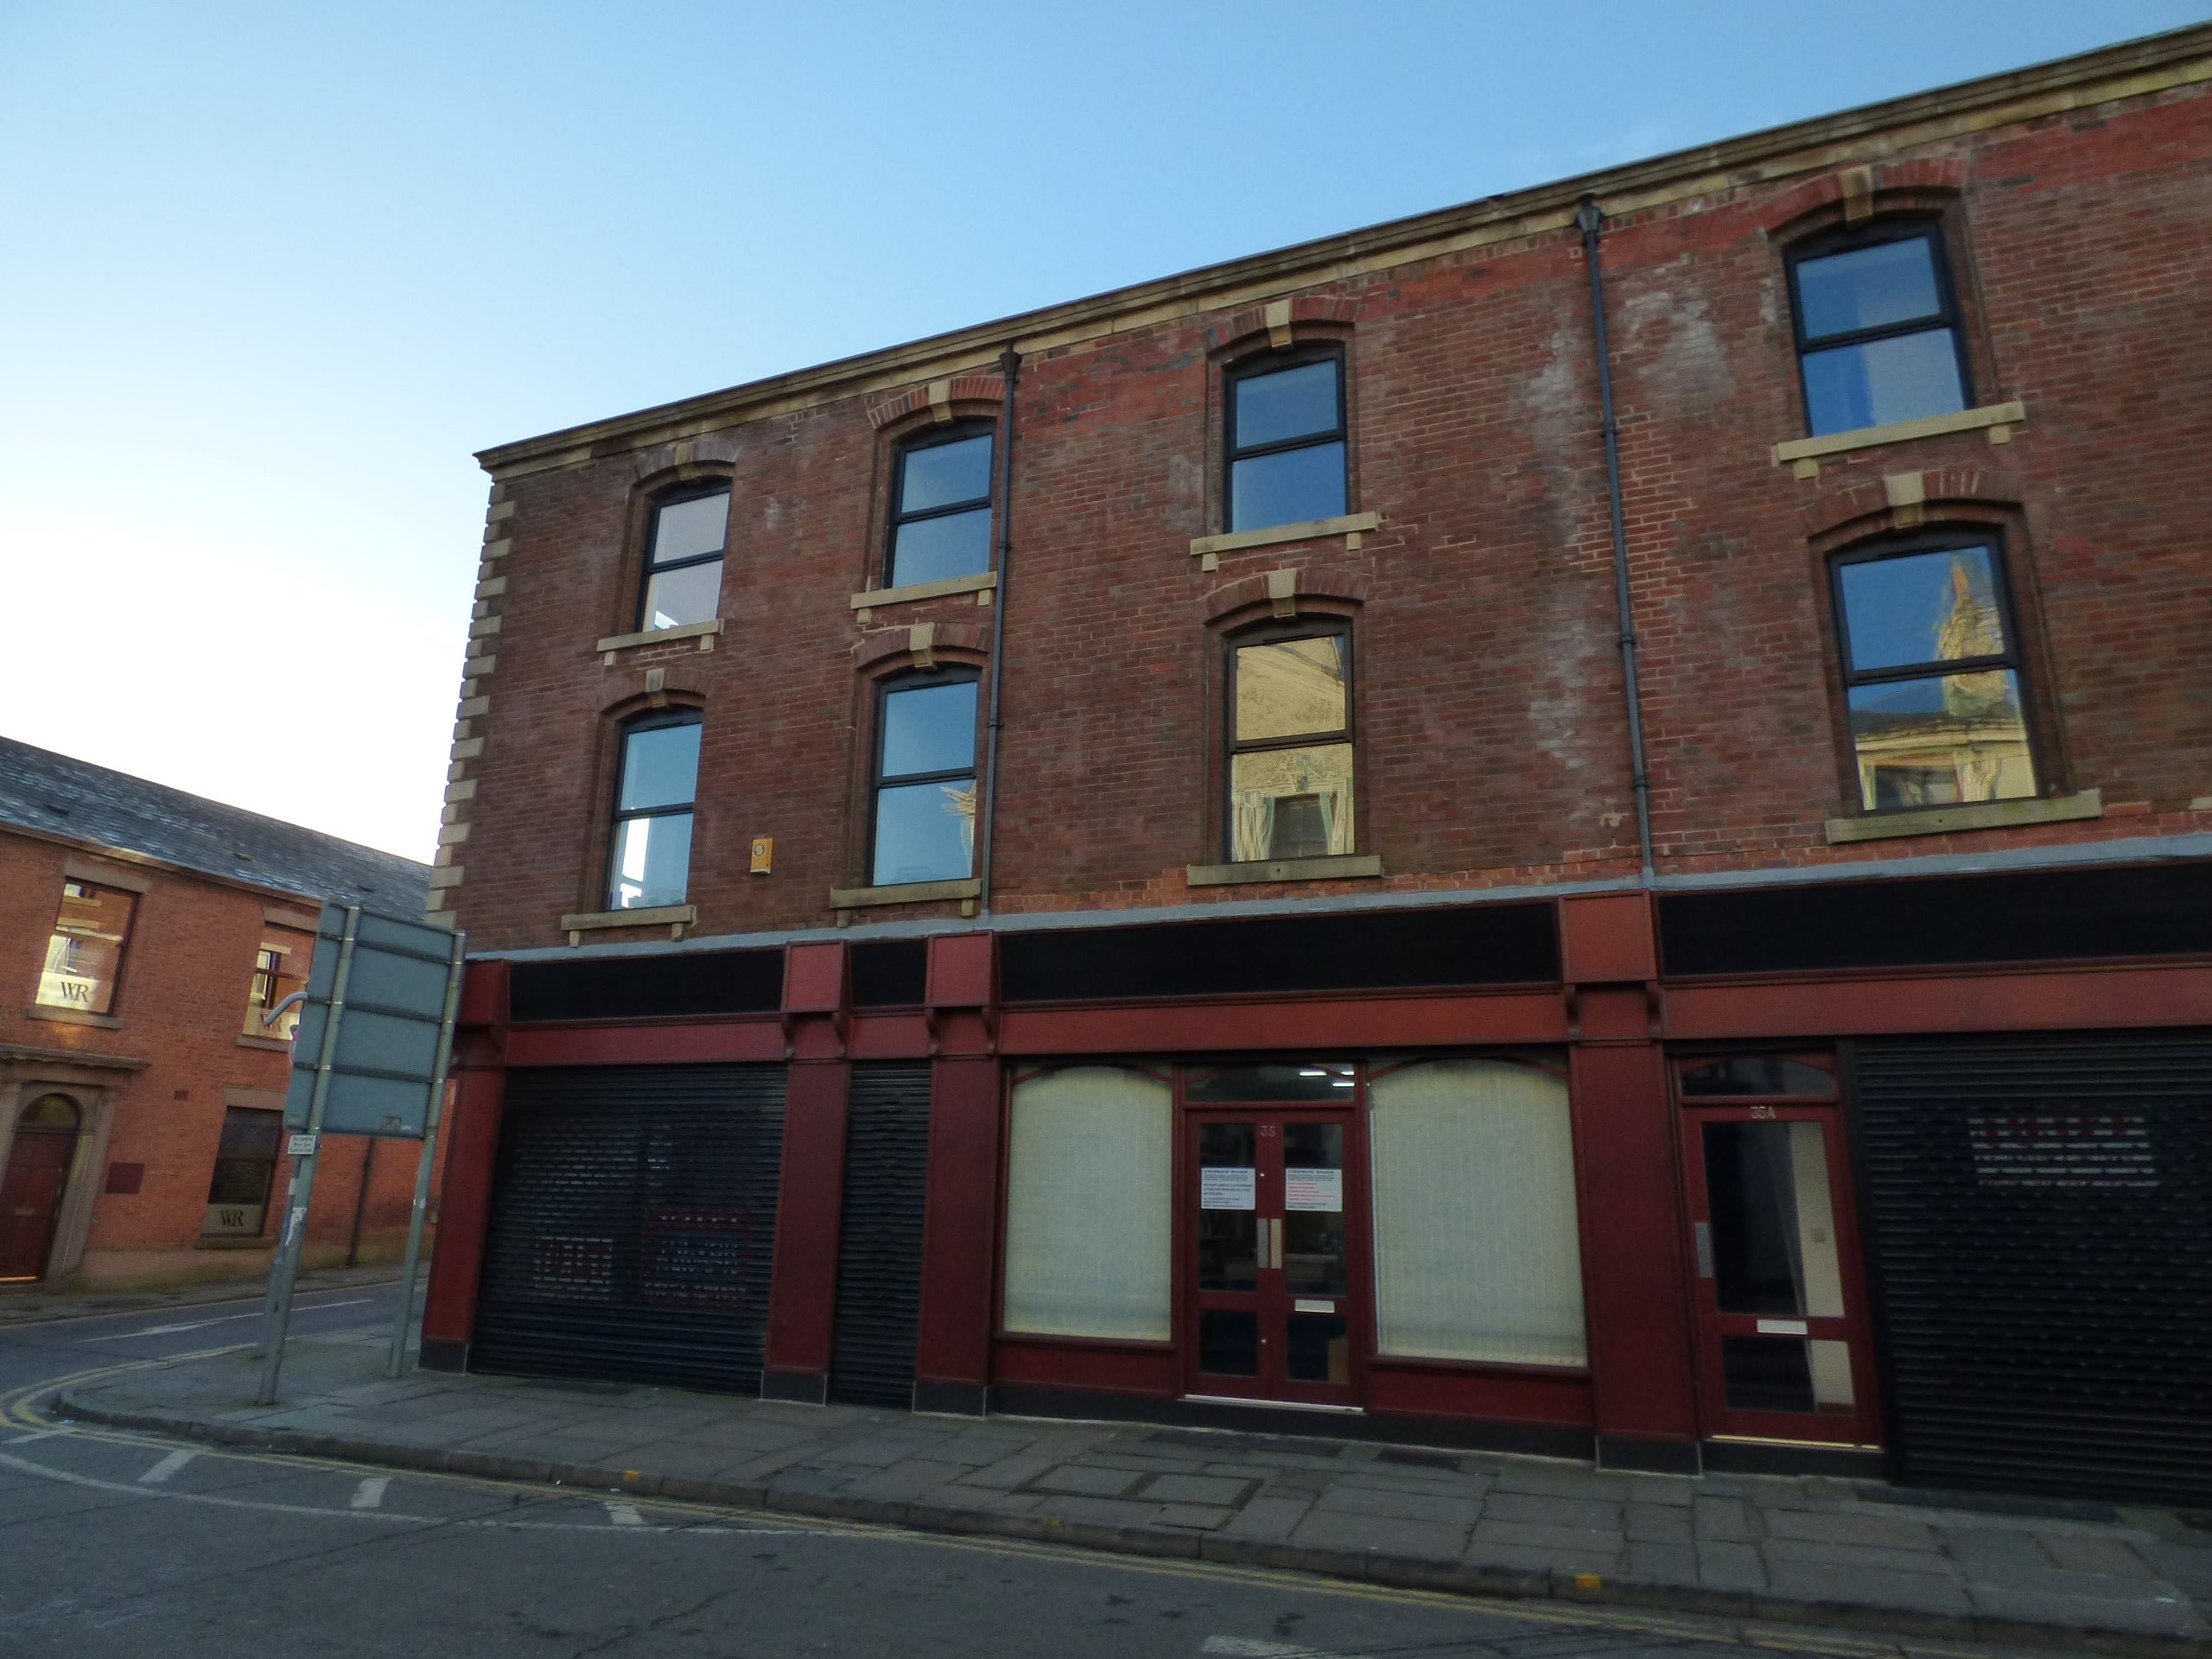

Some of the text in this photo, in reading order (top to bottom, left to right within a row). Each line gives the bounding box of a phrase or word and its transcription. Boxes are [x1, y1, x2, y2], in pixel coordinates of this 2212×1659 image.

[60, 982, 89, 1002] WR
[1259, 1125, 1276, 1137] 35
[221, 1210, 245, 1227] WR
